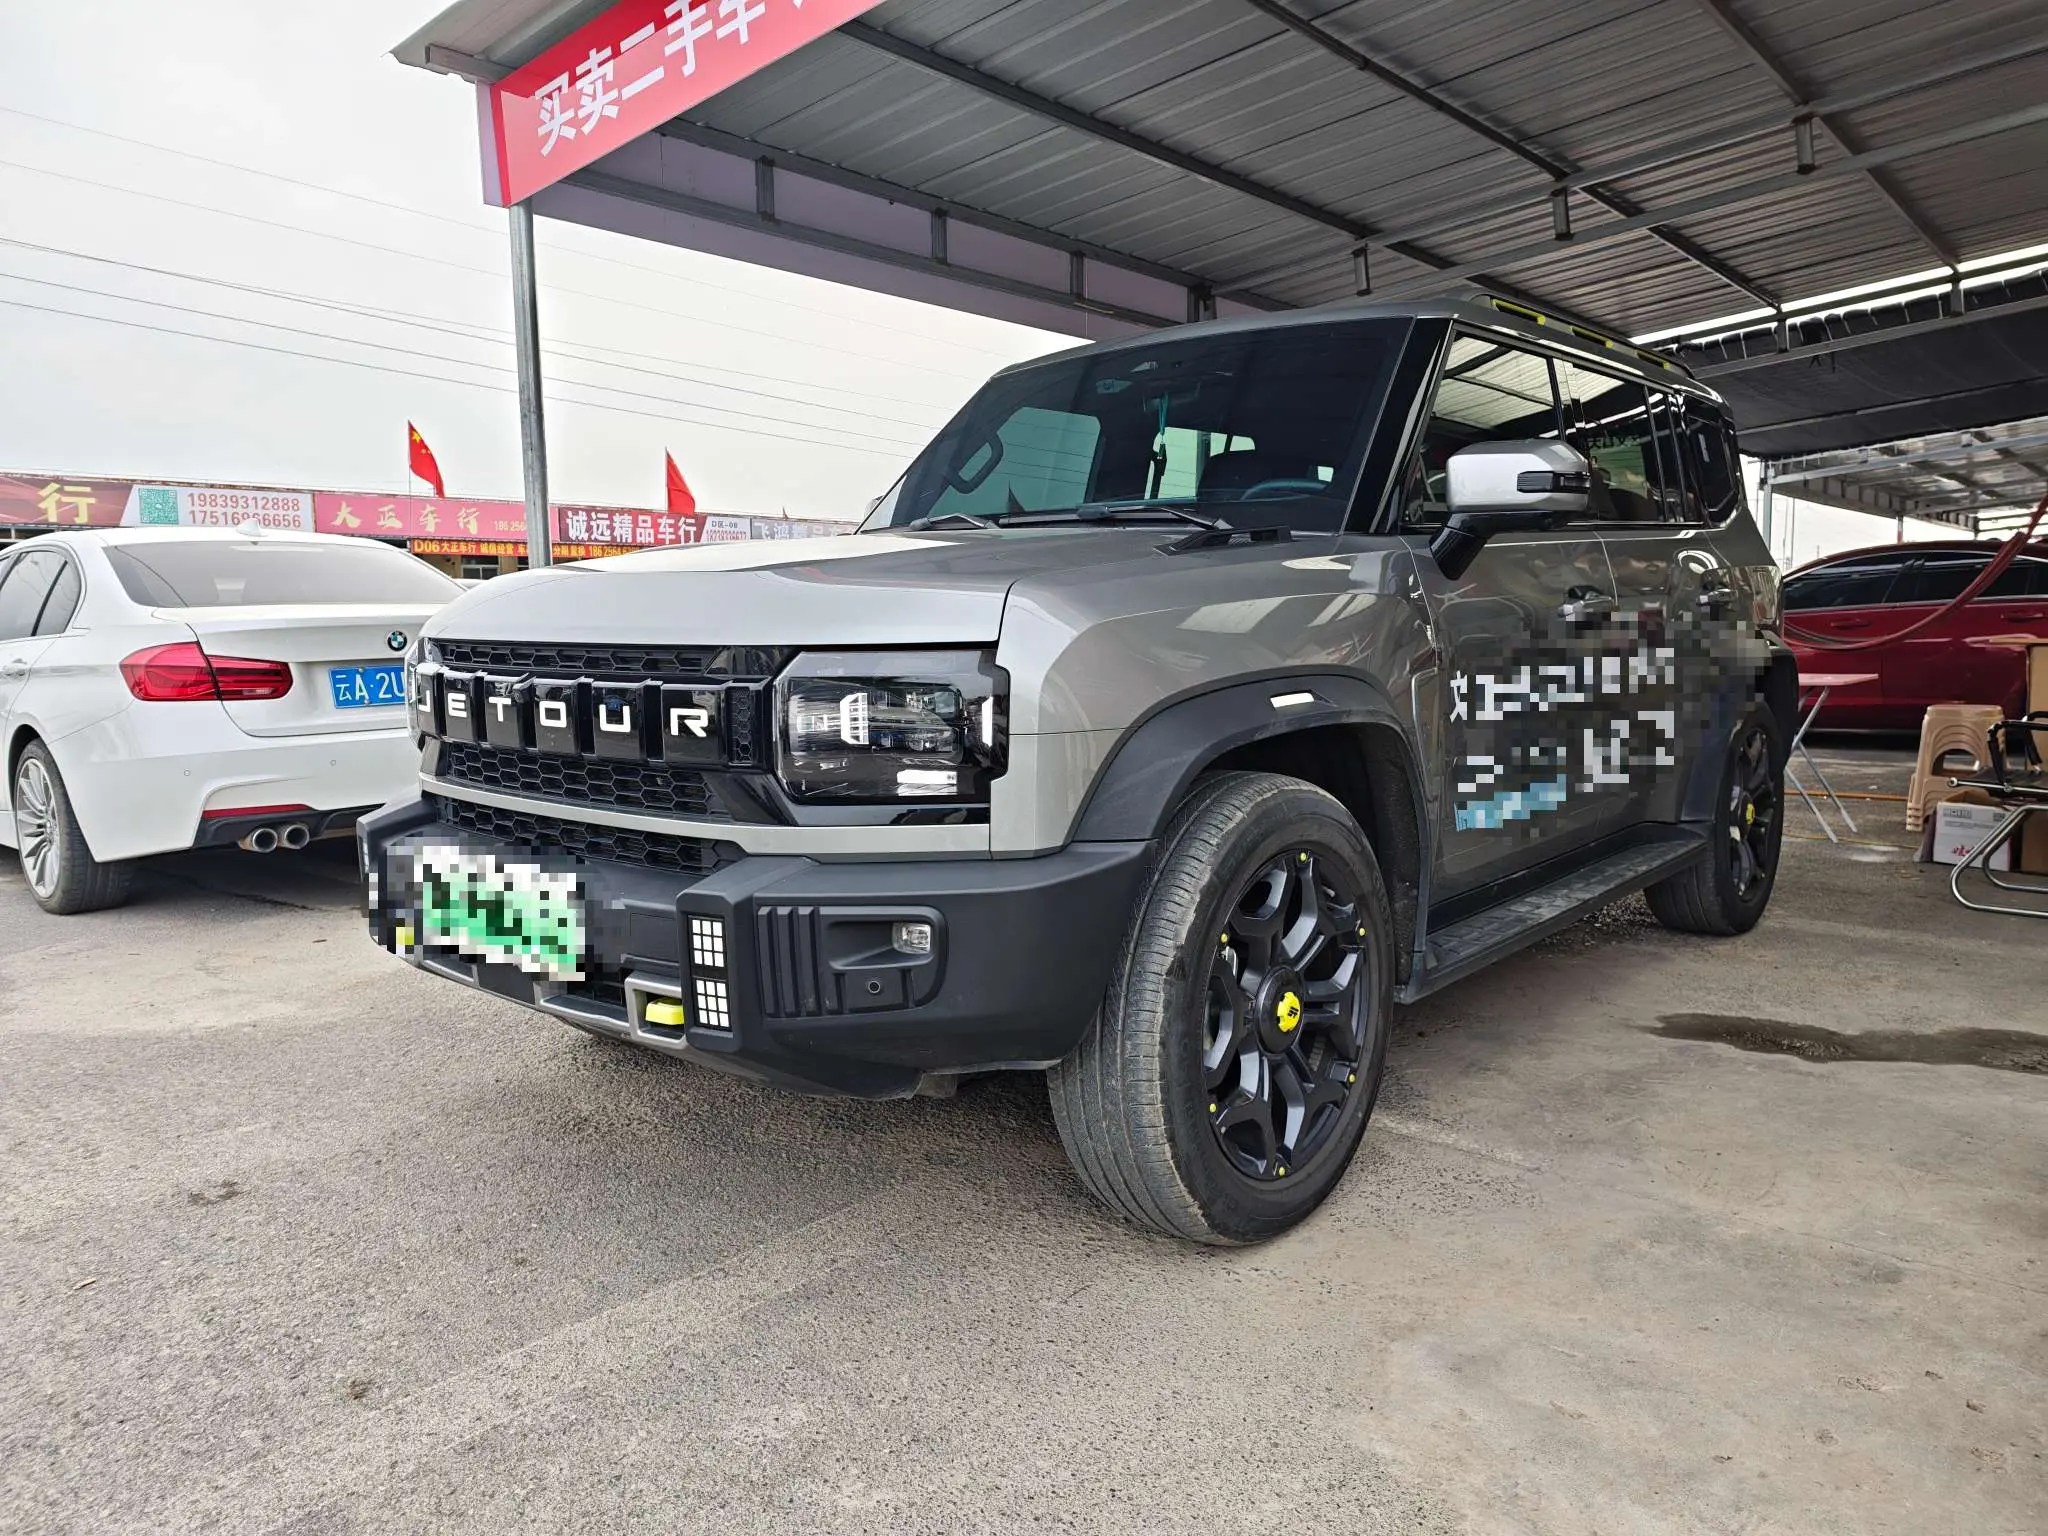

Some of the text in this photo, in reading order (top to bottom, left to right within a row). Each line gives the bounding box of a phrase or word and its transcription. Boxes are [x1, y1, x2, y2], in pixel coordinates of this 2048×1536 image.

[534, 0, 804, 156] 买卖二手车
[38, 482, 96, 524] 行
[187, 492, 300, 512] 19839312888
[331, 501, 481, 534] 大正车行
[566, 510, 698, 545] 诚远精品车行
[418, 690, 709, 738] JETOUR
